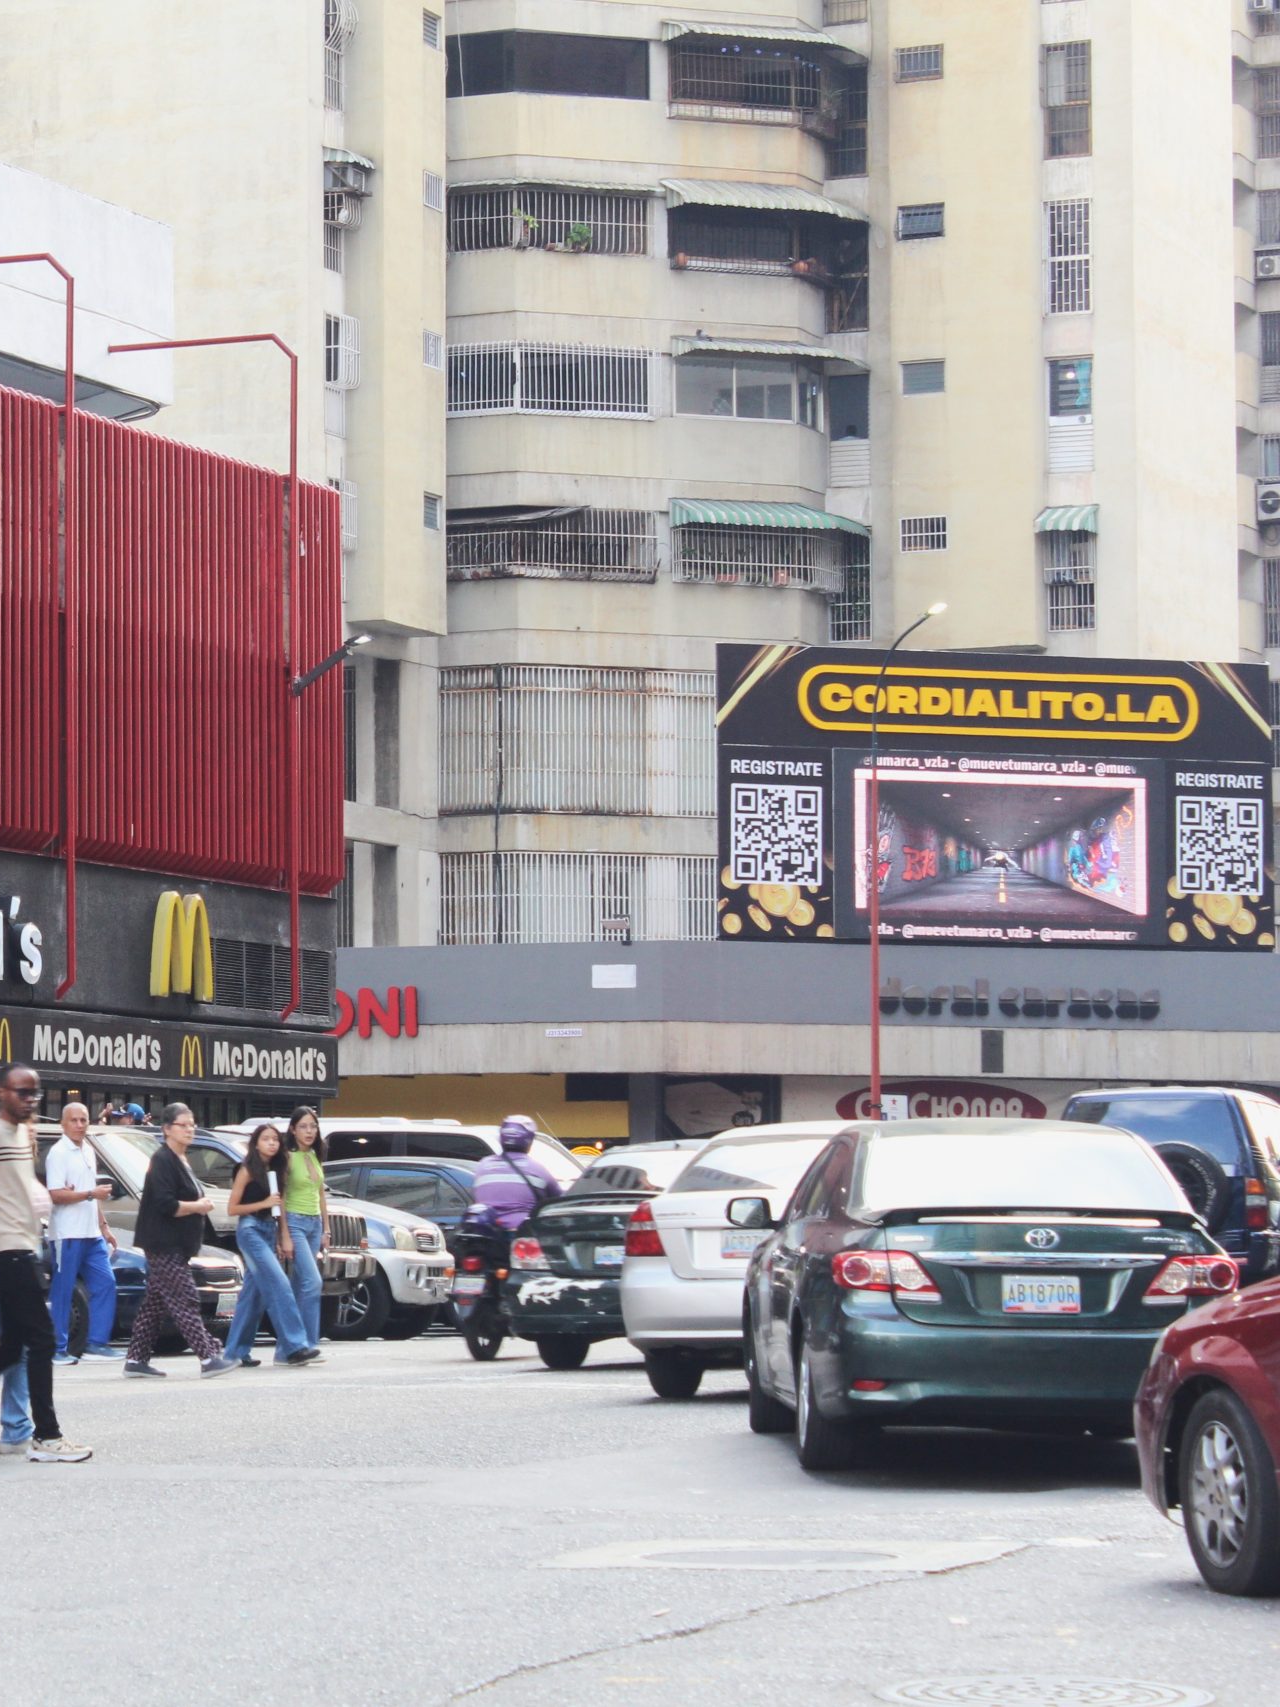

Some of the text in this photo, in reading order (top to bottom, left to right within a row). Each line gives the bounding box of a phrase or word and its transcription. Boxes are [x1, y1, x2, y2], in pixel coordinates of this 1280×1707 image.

[819, 682, 1180, 725] CORDIALITO.LA
[730, 758, 824, 778] REGISTRATE
[958, 756, 1086, 774] @muevetumarca_vzla
[1175, 771, 1264, 790] REGISTRATE
[33, 1024, 162, 1071] McDonald's
[213, 1040, 328, 1082] McDonald's
